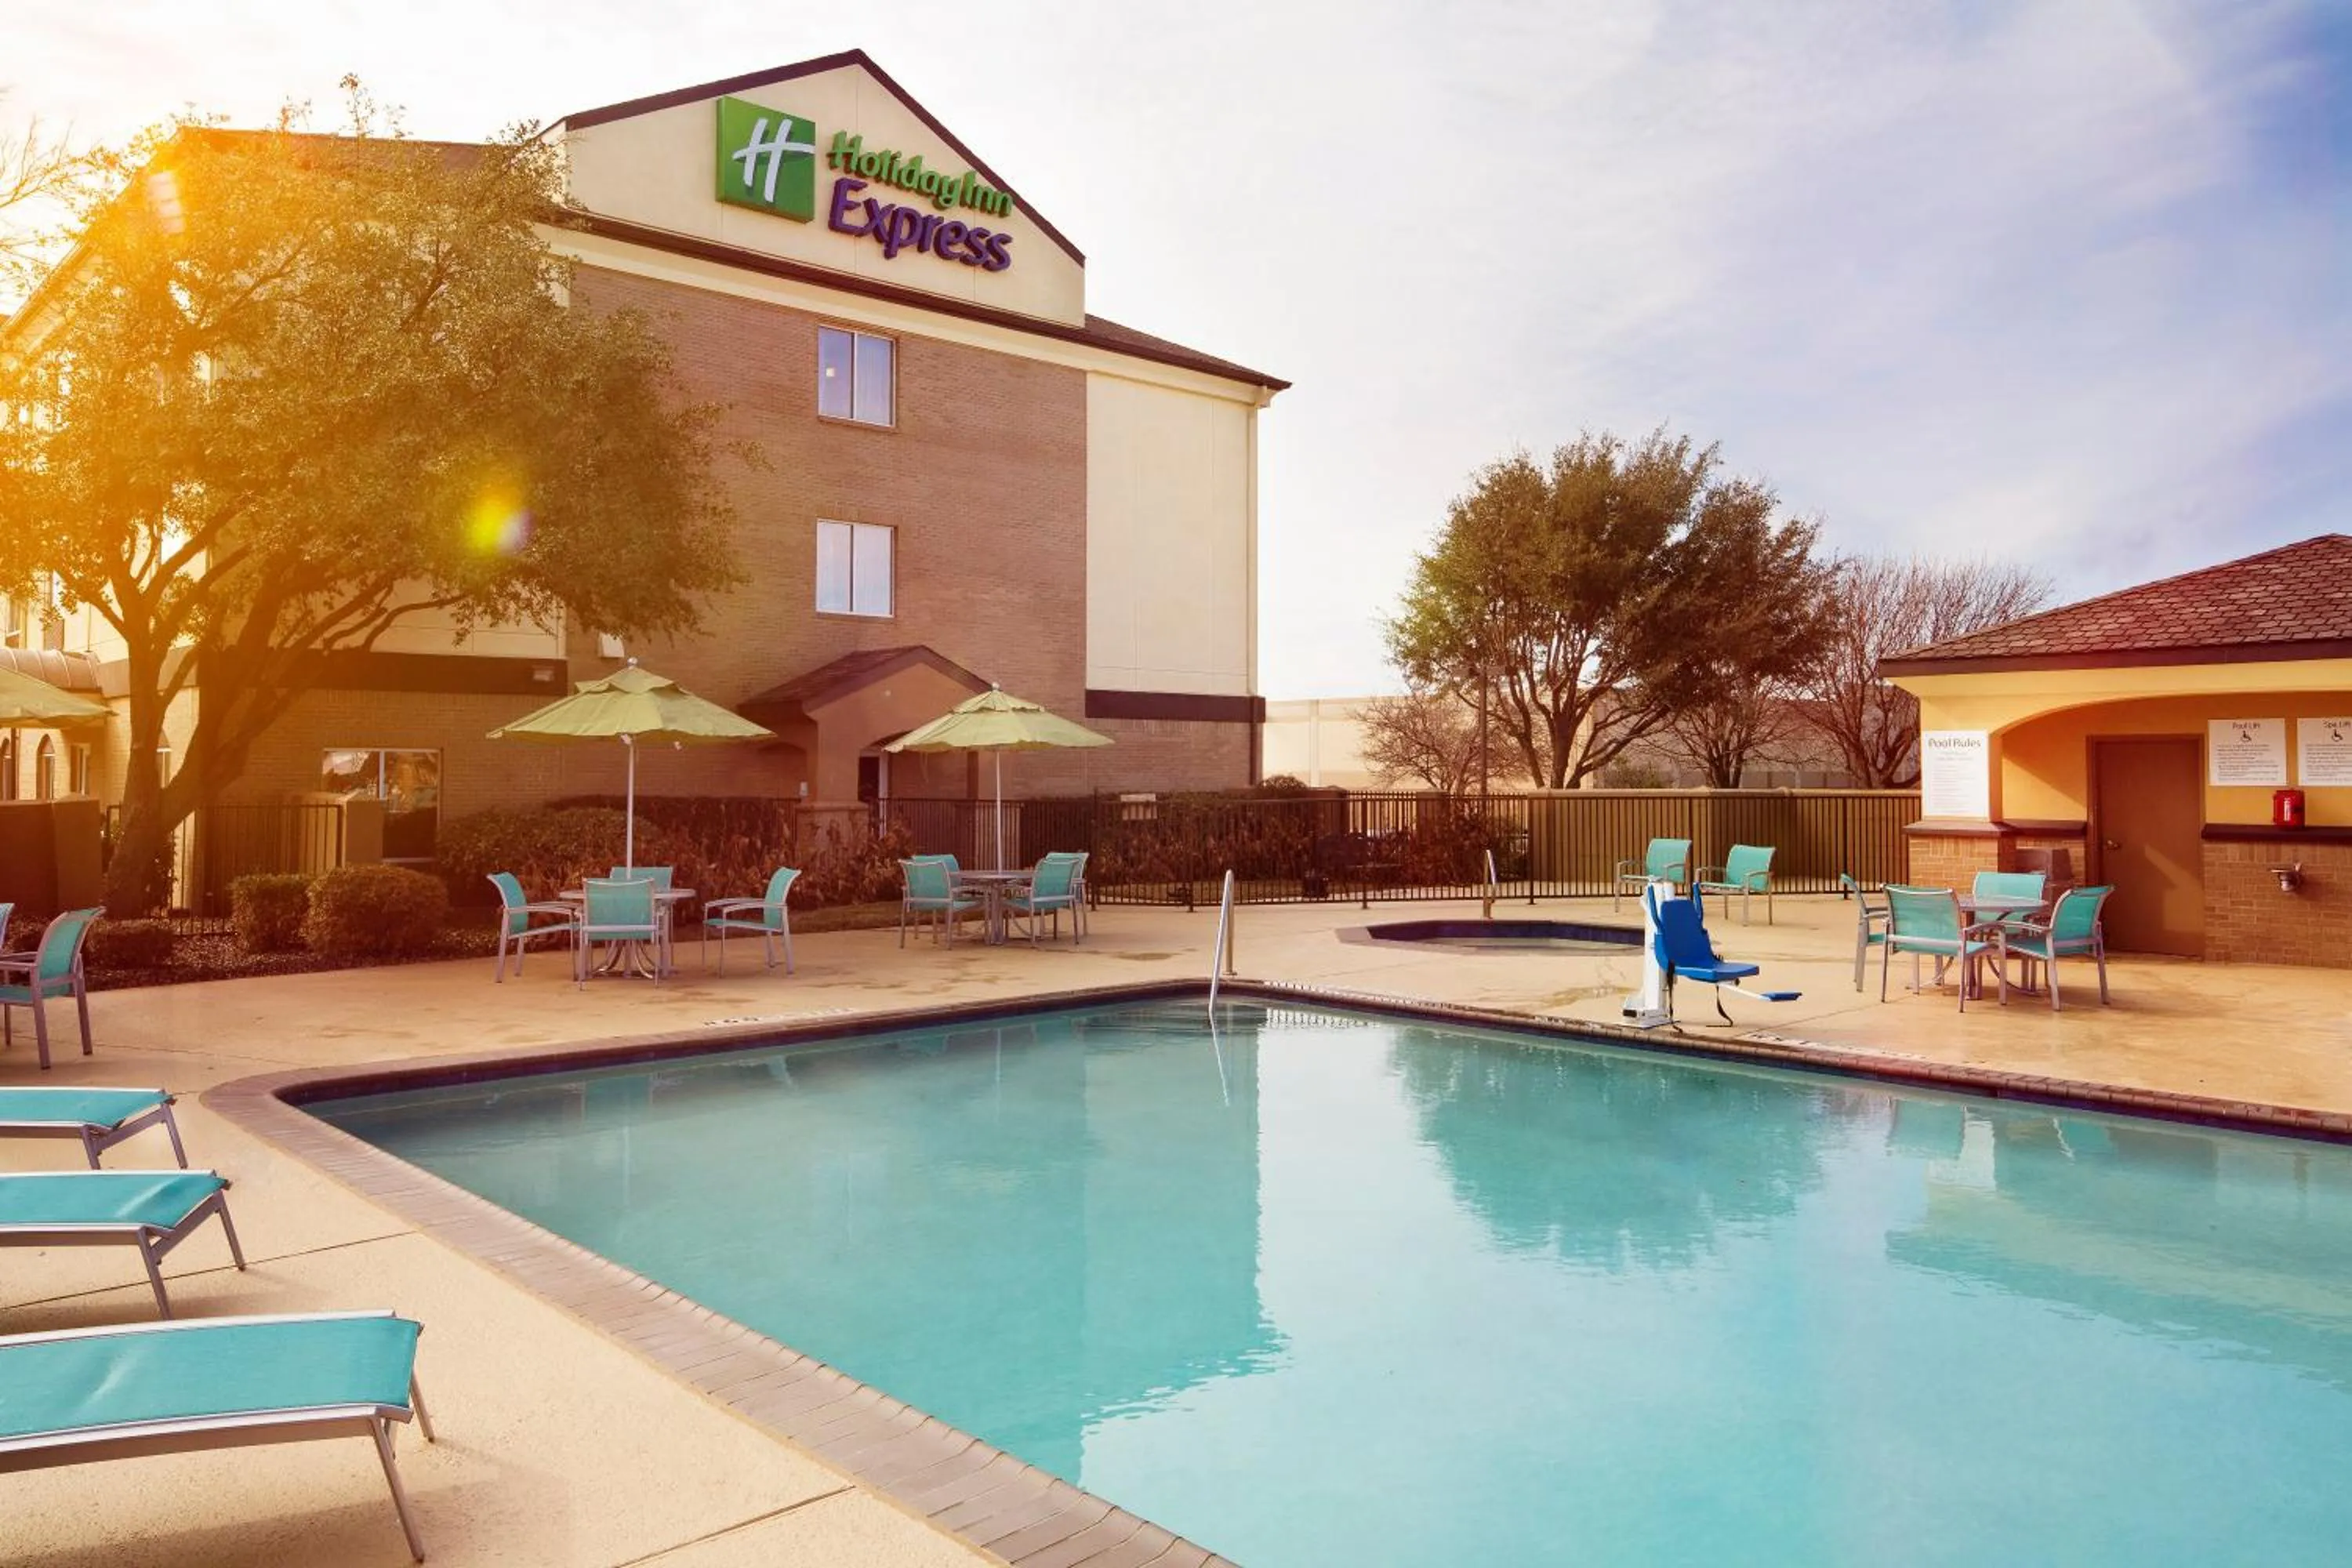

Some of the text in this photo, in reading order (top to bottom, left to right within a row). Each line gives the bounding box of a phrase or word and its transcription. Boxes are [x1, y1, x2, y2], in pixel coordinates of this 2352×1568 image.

[827, 130, 1012, 217] Holiday Inn
[828, 177, 1012, 272] Express
[1928, 738, 1981, 748] Pool Rules
